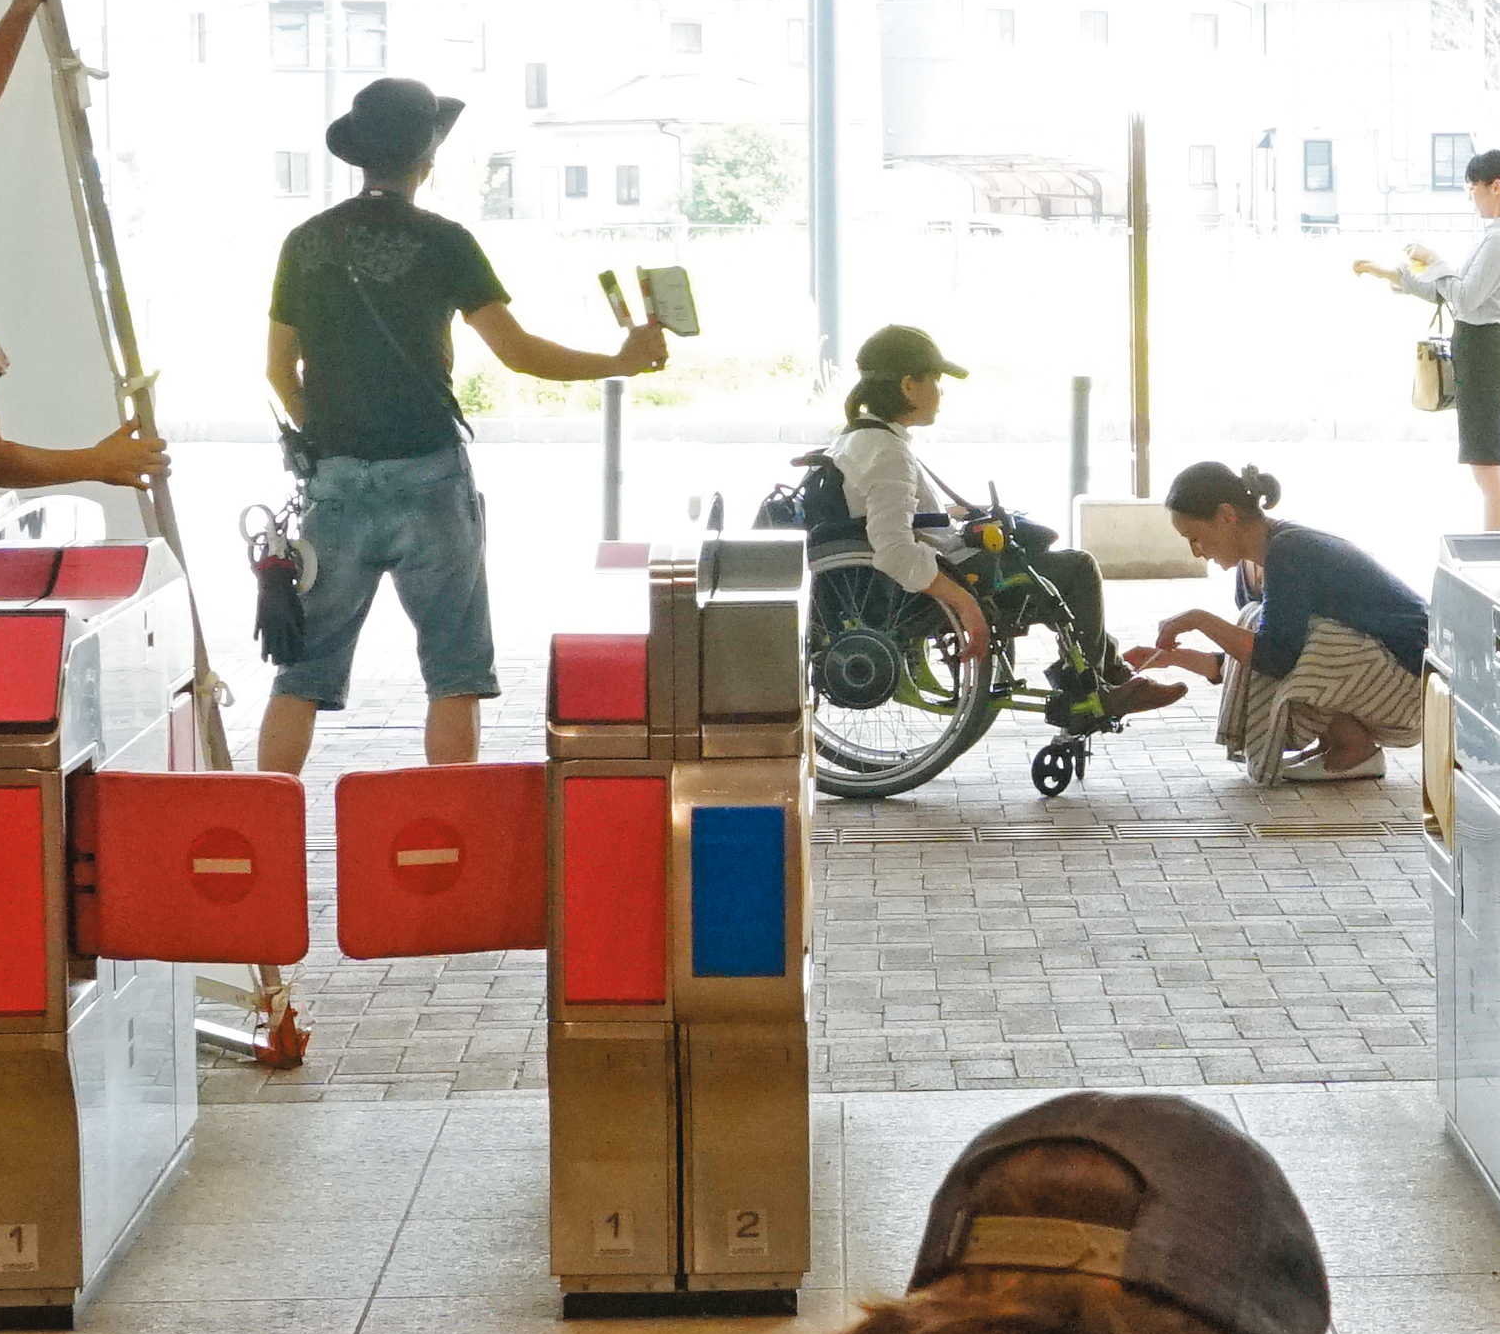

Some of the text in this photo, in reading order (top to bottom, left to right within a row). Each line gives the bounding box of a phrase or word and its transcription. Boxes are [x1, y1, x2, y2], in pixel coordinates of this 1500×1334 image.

[605, 1212, 619, 1238] 1
[736, 1211, 760, 1238] 2
[9, 1226, 23, 1253] 1
